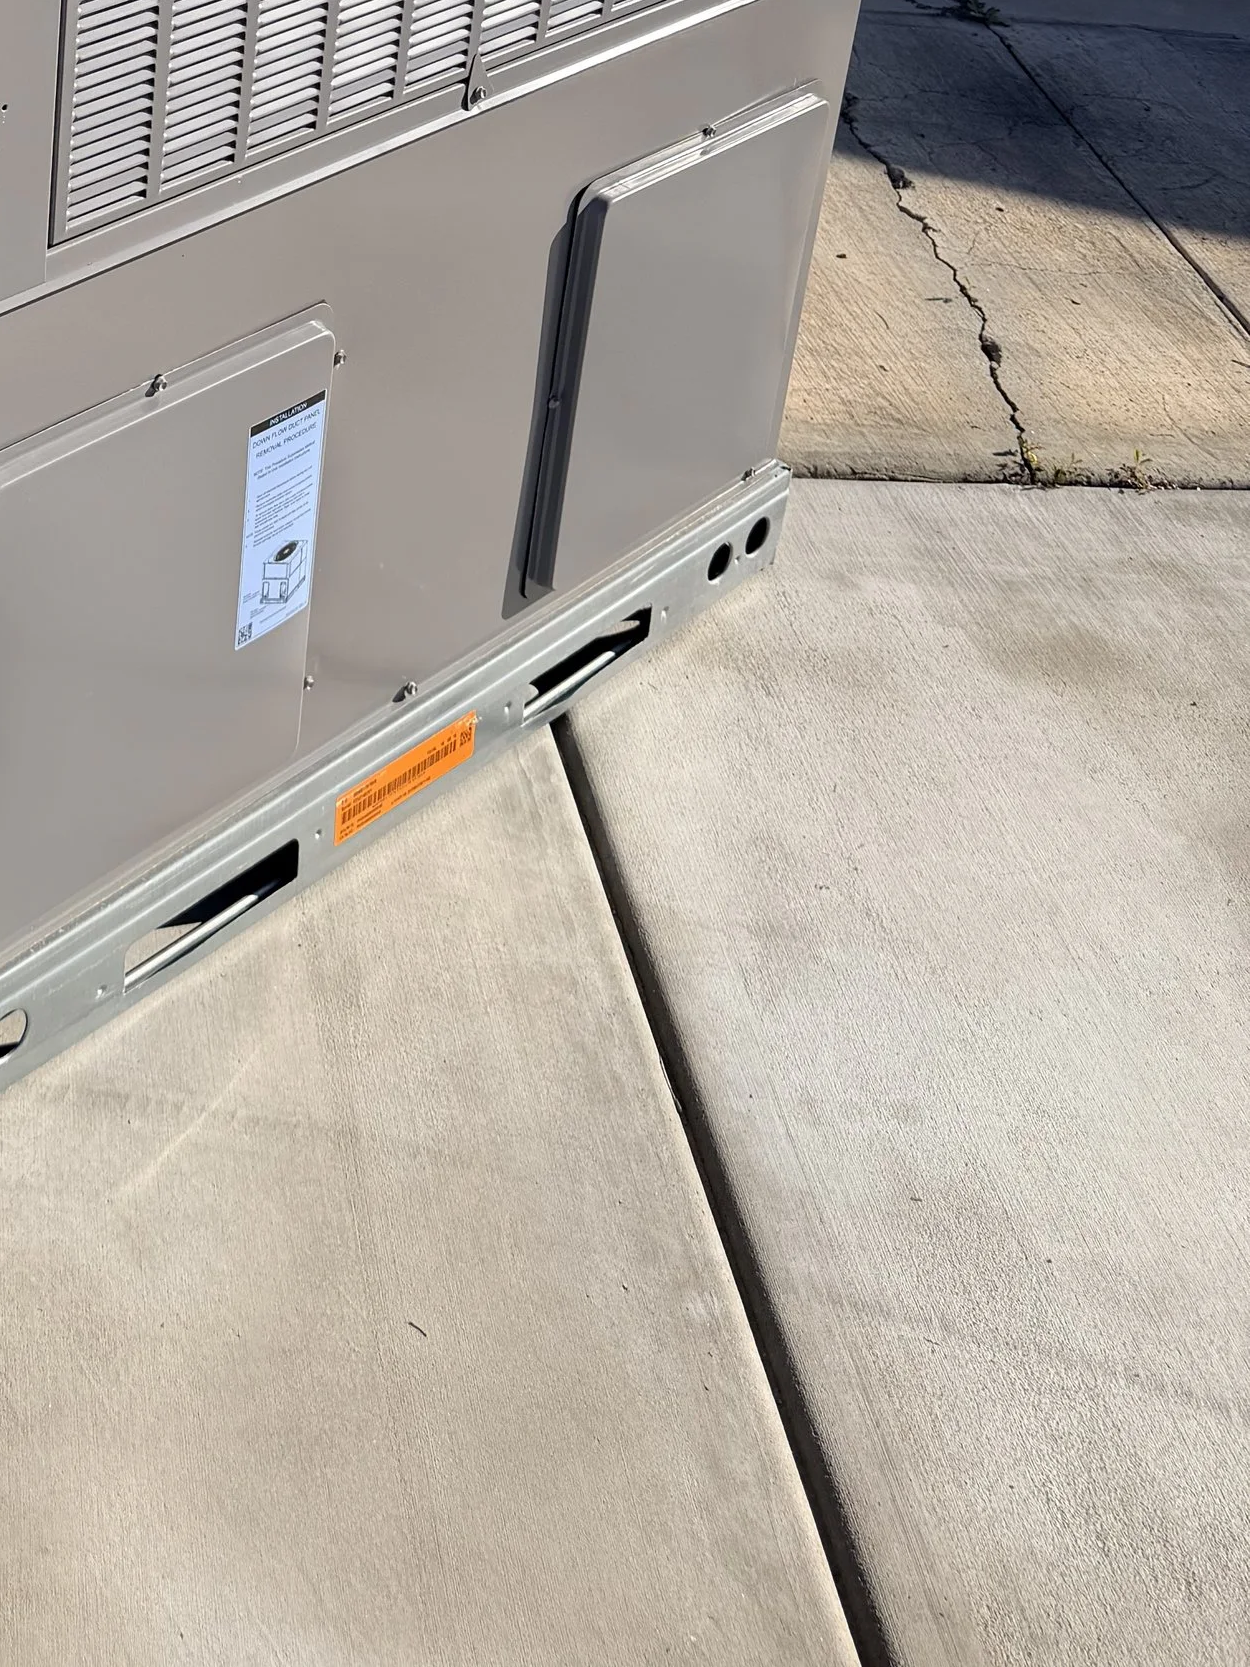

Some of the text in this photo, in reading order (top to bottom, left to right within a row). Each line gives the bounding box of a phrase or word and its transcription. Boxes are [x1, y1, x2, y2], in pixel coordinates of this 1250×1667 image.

[252, 409, 320, 449] DOWN FLOW DUCT PANEL
[269, 402, 308, 426] INSTALLATION
[256, 422, 317, 458] REMOVAL PROCEDURE
